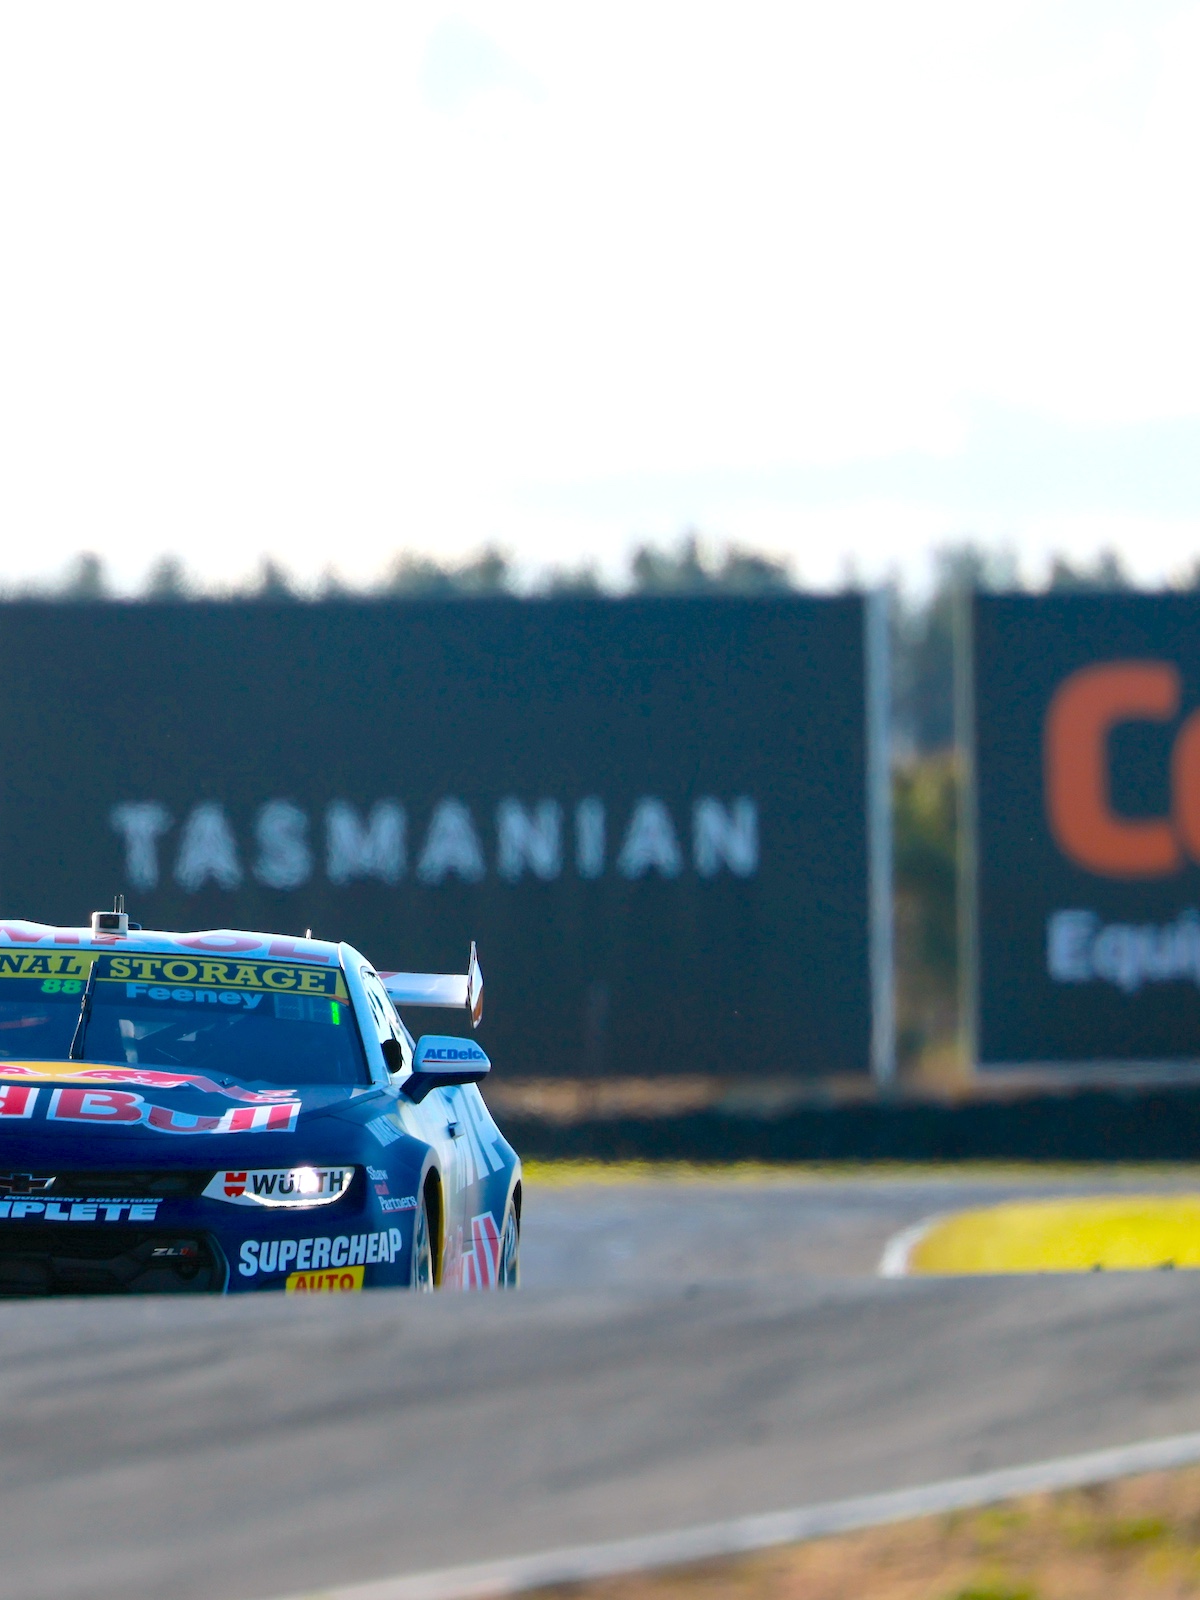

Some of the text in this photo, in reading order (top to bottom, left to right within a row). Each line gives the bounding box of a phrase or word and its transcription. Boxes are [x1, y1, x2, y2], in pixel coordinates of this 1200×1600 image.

[1043, 658, 1200, 880] C
[111, 797, 758, 890] TASMANIAN
[1047, 908, 1200, 992] Equi
[40, 978, 82, 994] 88
[110, 958, 326, 992] STORAGE
[126, 983, 264, 1009] Feeney
[47, 1088, 302, 1135] Bull
[252, 1171, 344, 1194] WÜTH
[378, 1195, 417, 1211] Partners
[238, 1228, 402, 1277] SUPERCHEAP
[294, 1273, 354, 1292] AUTO
